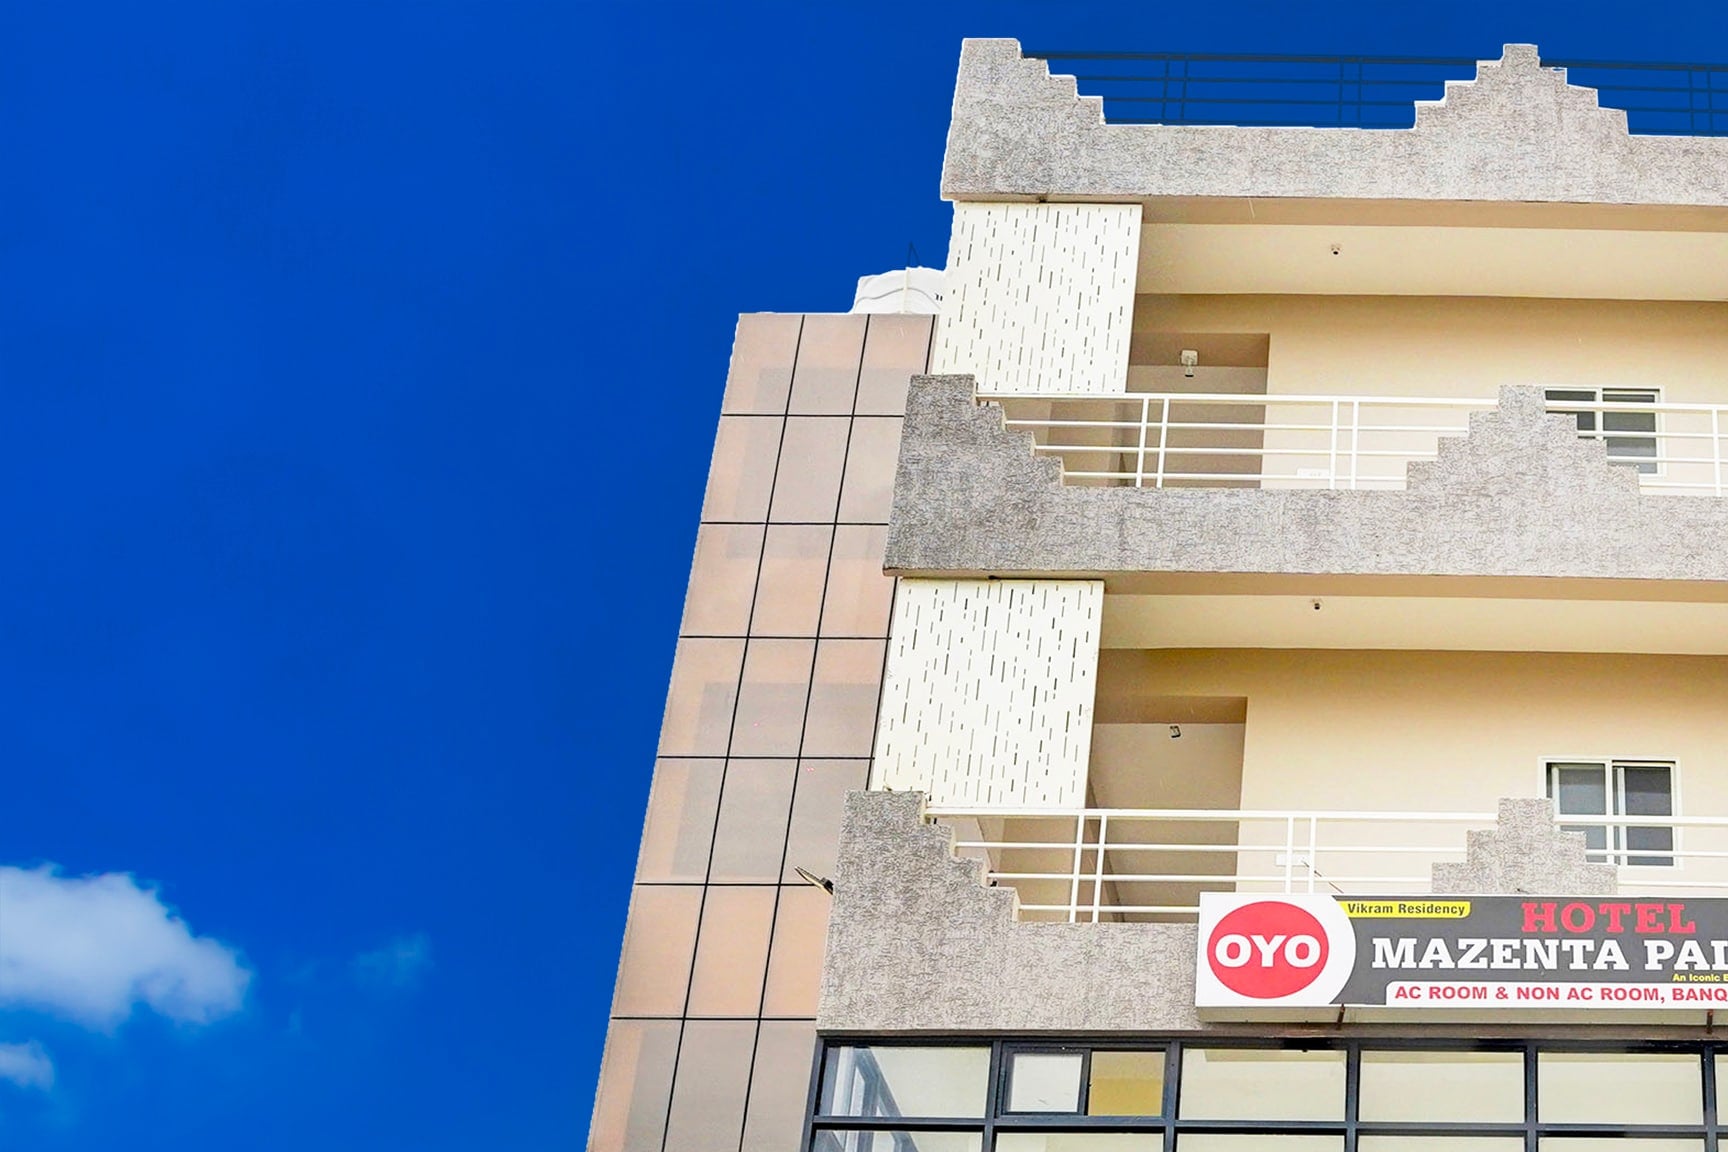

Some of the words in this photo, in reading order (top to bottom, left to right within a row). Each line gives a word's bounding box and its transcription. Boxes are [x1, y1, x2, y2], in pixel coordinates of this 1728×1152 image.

[1347, 904, 1393, 913] Vikram
[1398, 904, 1465, 916] Residency
[1521, 902, 1696, 933] HOTEL
[1215, 935, 1321, 967] OYO
[1371, 938, 1630, 970] MAZENTA
[1672, 973, 1686, 982] An
[1689, 973, 1720, 982] Iconic
[1395, 986, 1421, 999] AC
[1429, 986, 1488, 1000] ROOM
[1495, 987, 1509, 1000] &
[1516, 987, 1560, 1000] NON
[1567, 987, 1593, 1000] AC
[1600, 988, 1665, 1004] ROOM,
